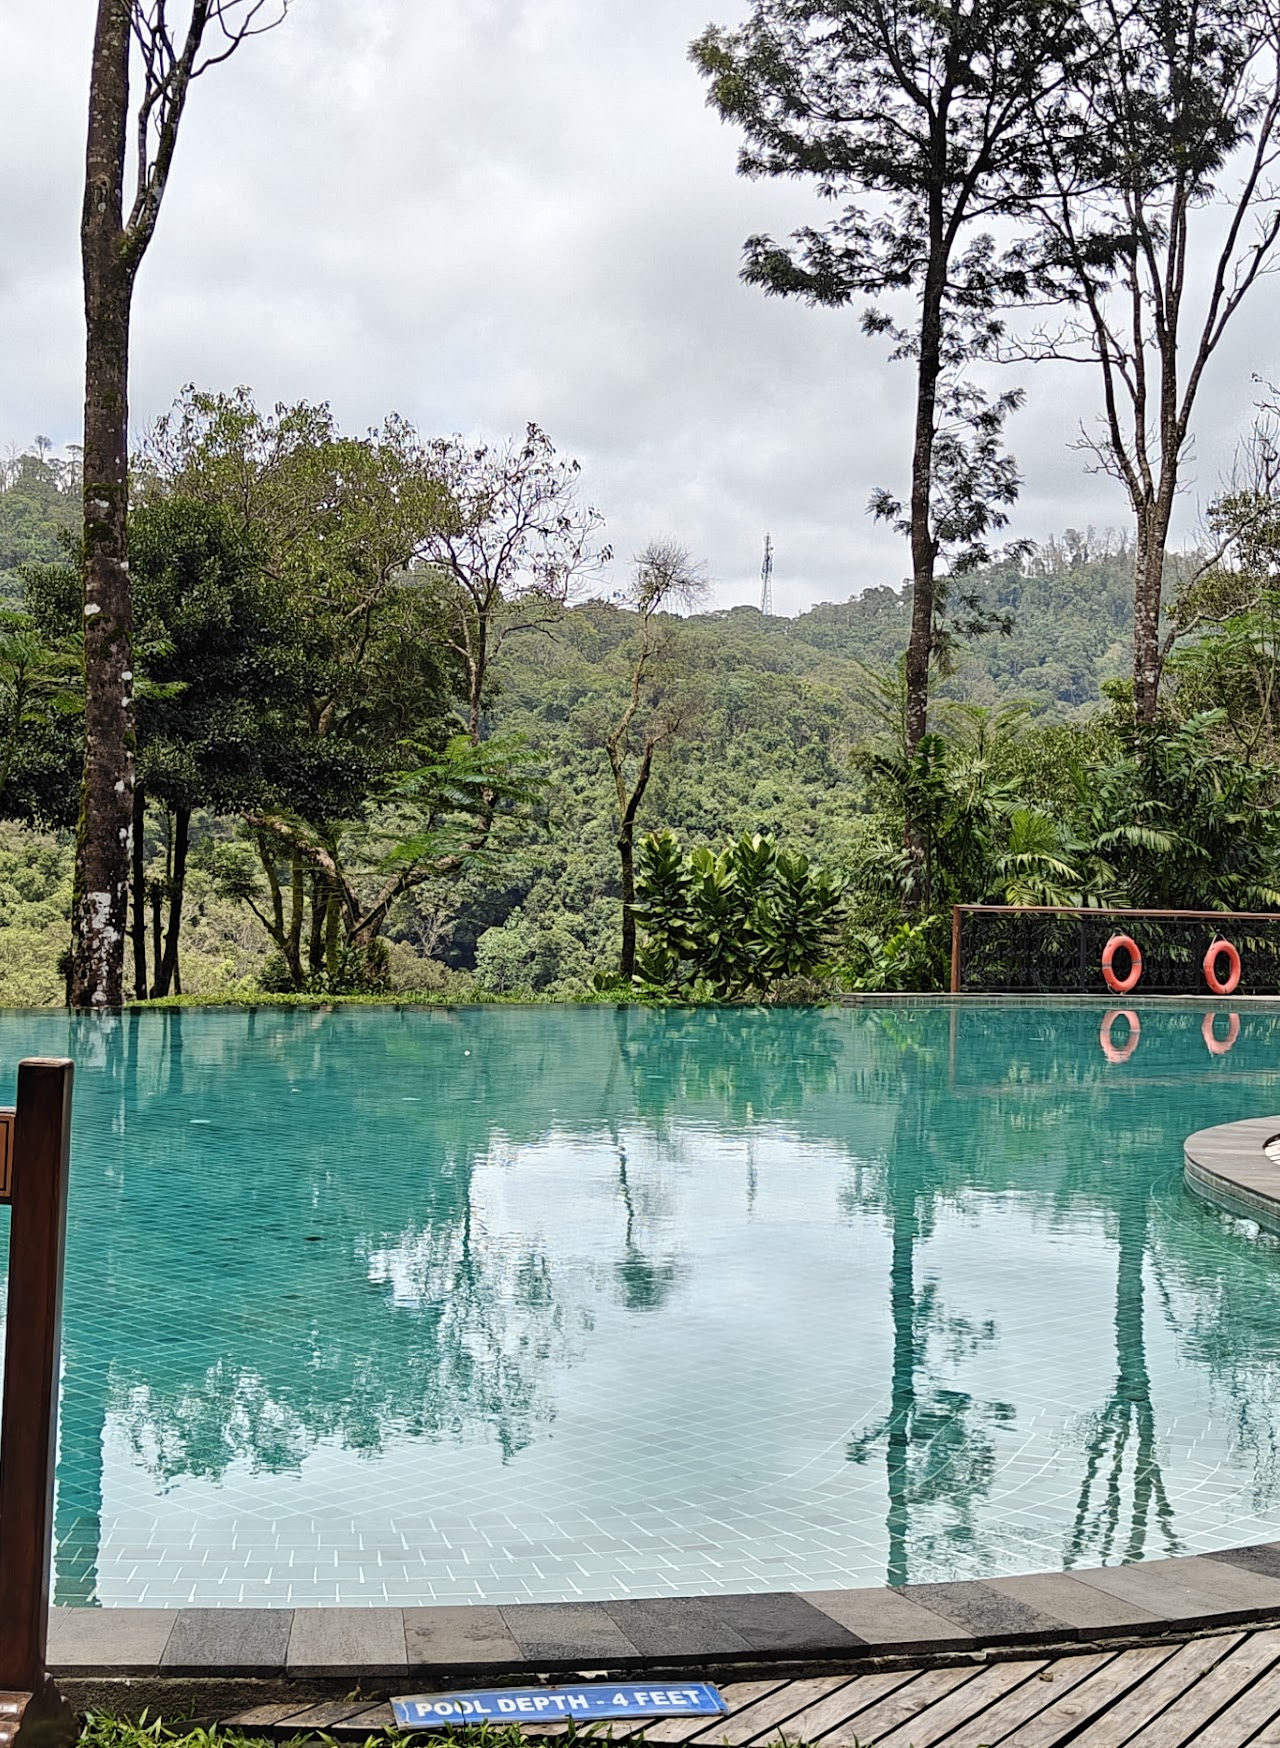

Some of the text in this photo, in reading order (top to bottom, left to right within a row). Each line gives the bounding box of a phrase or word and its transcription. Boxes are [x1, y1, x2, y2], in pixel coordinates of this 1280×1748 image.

[415, 1700, 491, 1717] POOL
[499, 1694, 589, 1713] DEPTH
[611, 1692, 629, 1708] 4
[634, 1690, 700, 1706] FEET
